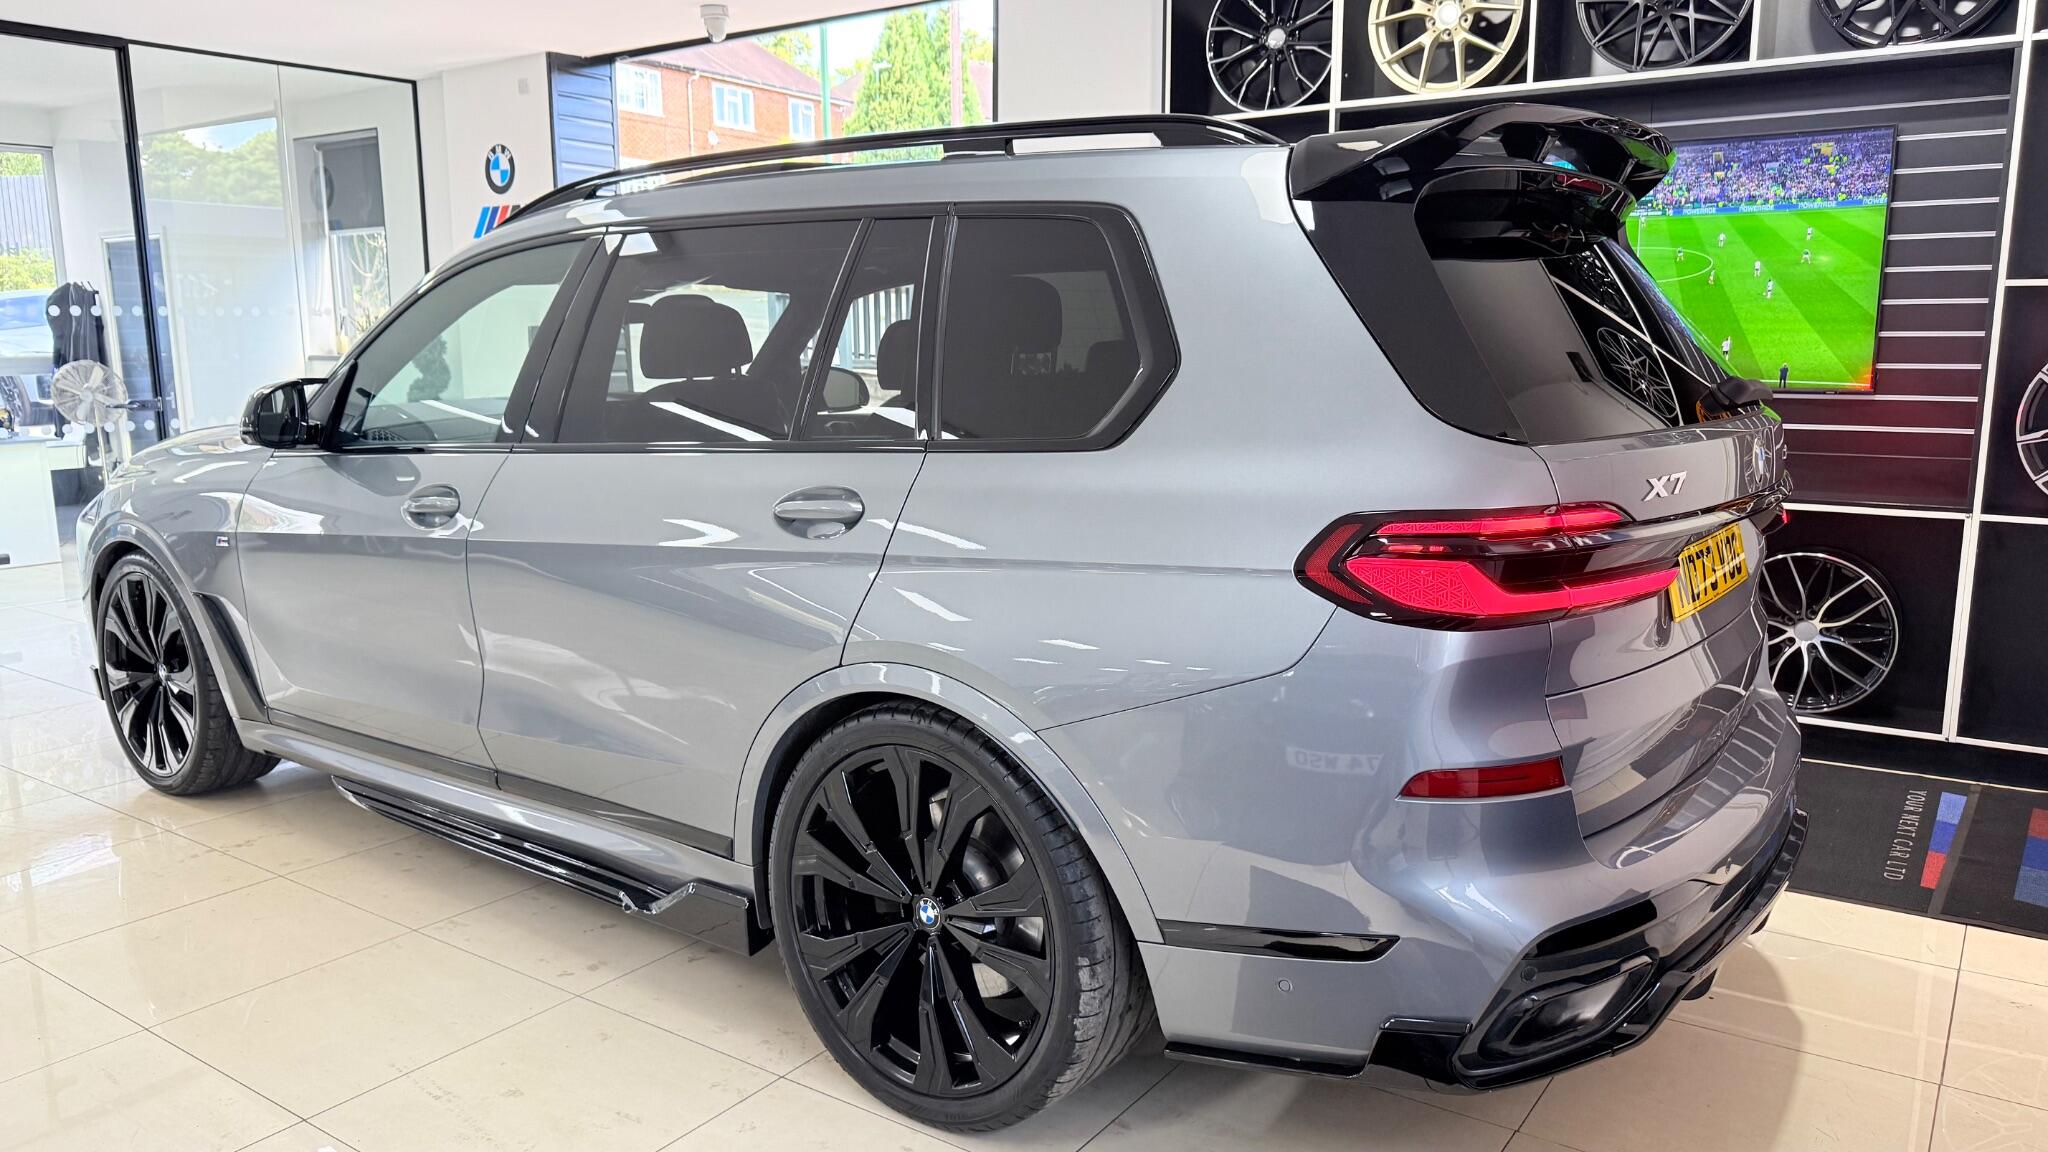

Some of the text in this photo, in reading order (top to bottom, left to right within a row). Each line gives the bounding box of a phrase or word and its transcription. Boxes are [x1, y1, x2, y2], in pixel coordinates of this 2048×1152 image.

[1643, 470, 1687, 502] X7
[1883, 790, 1927, 880] YOUR NEXT CAR LTD
